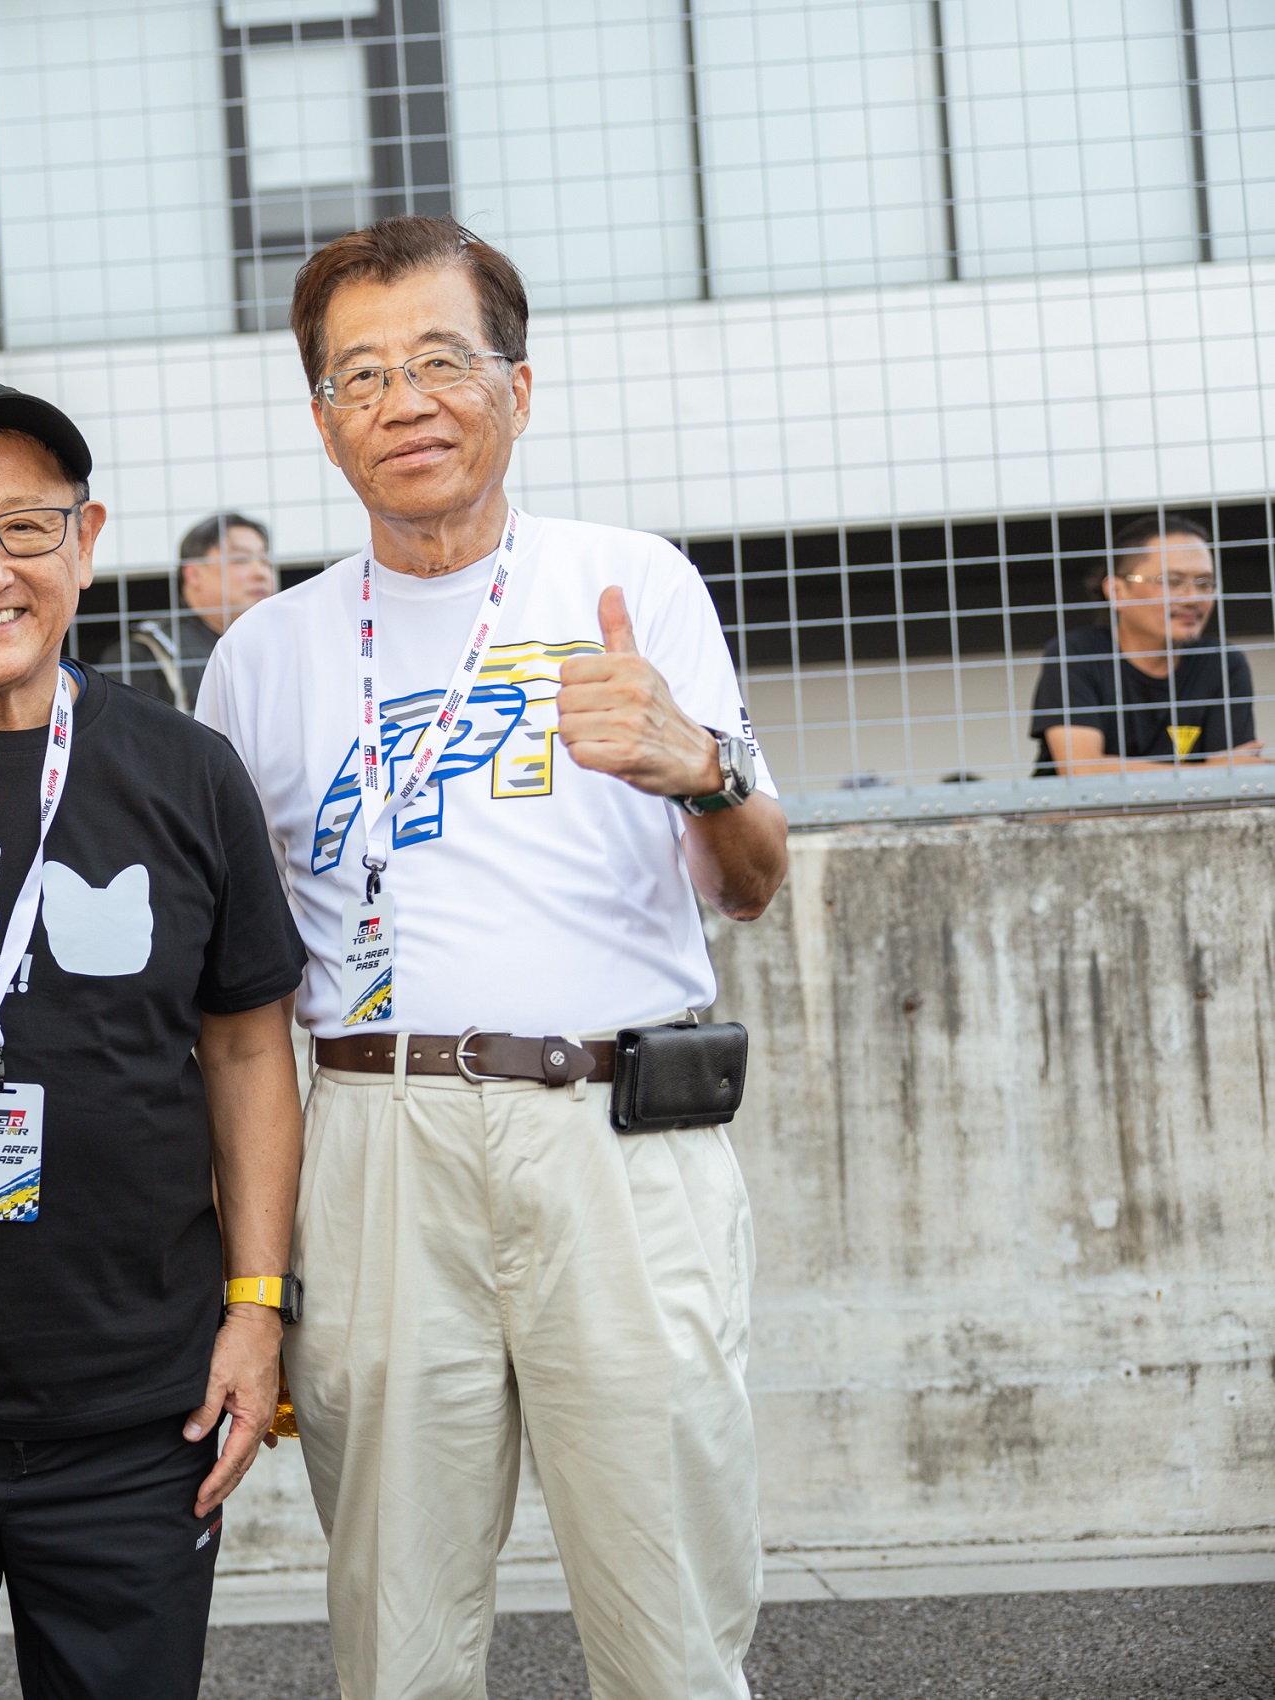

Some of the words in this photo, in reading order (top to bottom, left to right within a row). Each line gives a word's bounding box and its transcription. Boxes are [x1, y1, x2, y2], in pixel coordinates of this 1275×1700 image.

[464, 648, 480, 672] ROOKIE
[363, 677, 373, 700] ROOKIE
[400, 772, 420, 799] ROOKIE
[415, 748, 434, 776] RACING
[357, 920, 380, 937] GR
[346, 953, 362, 963] ALL
[364, 948, 389, 961] AREA
[355, 960, 380, 972] PASS
[2, 1145, 38, 1154] AREA
